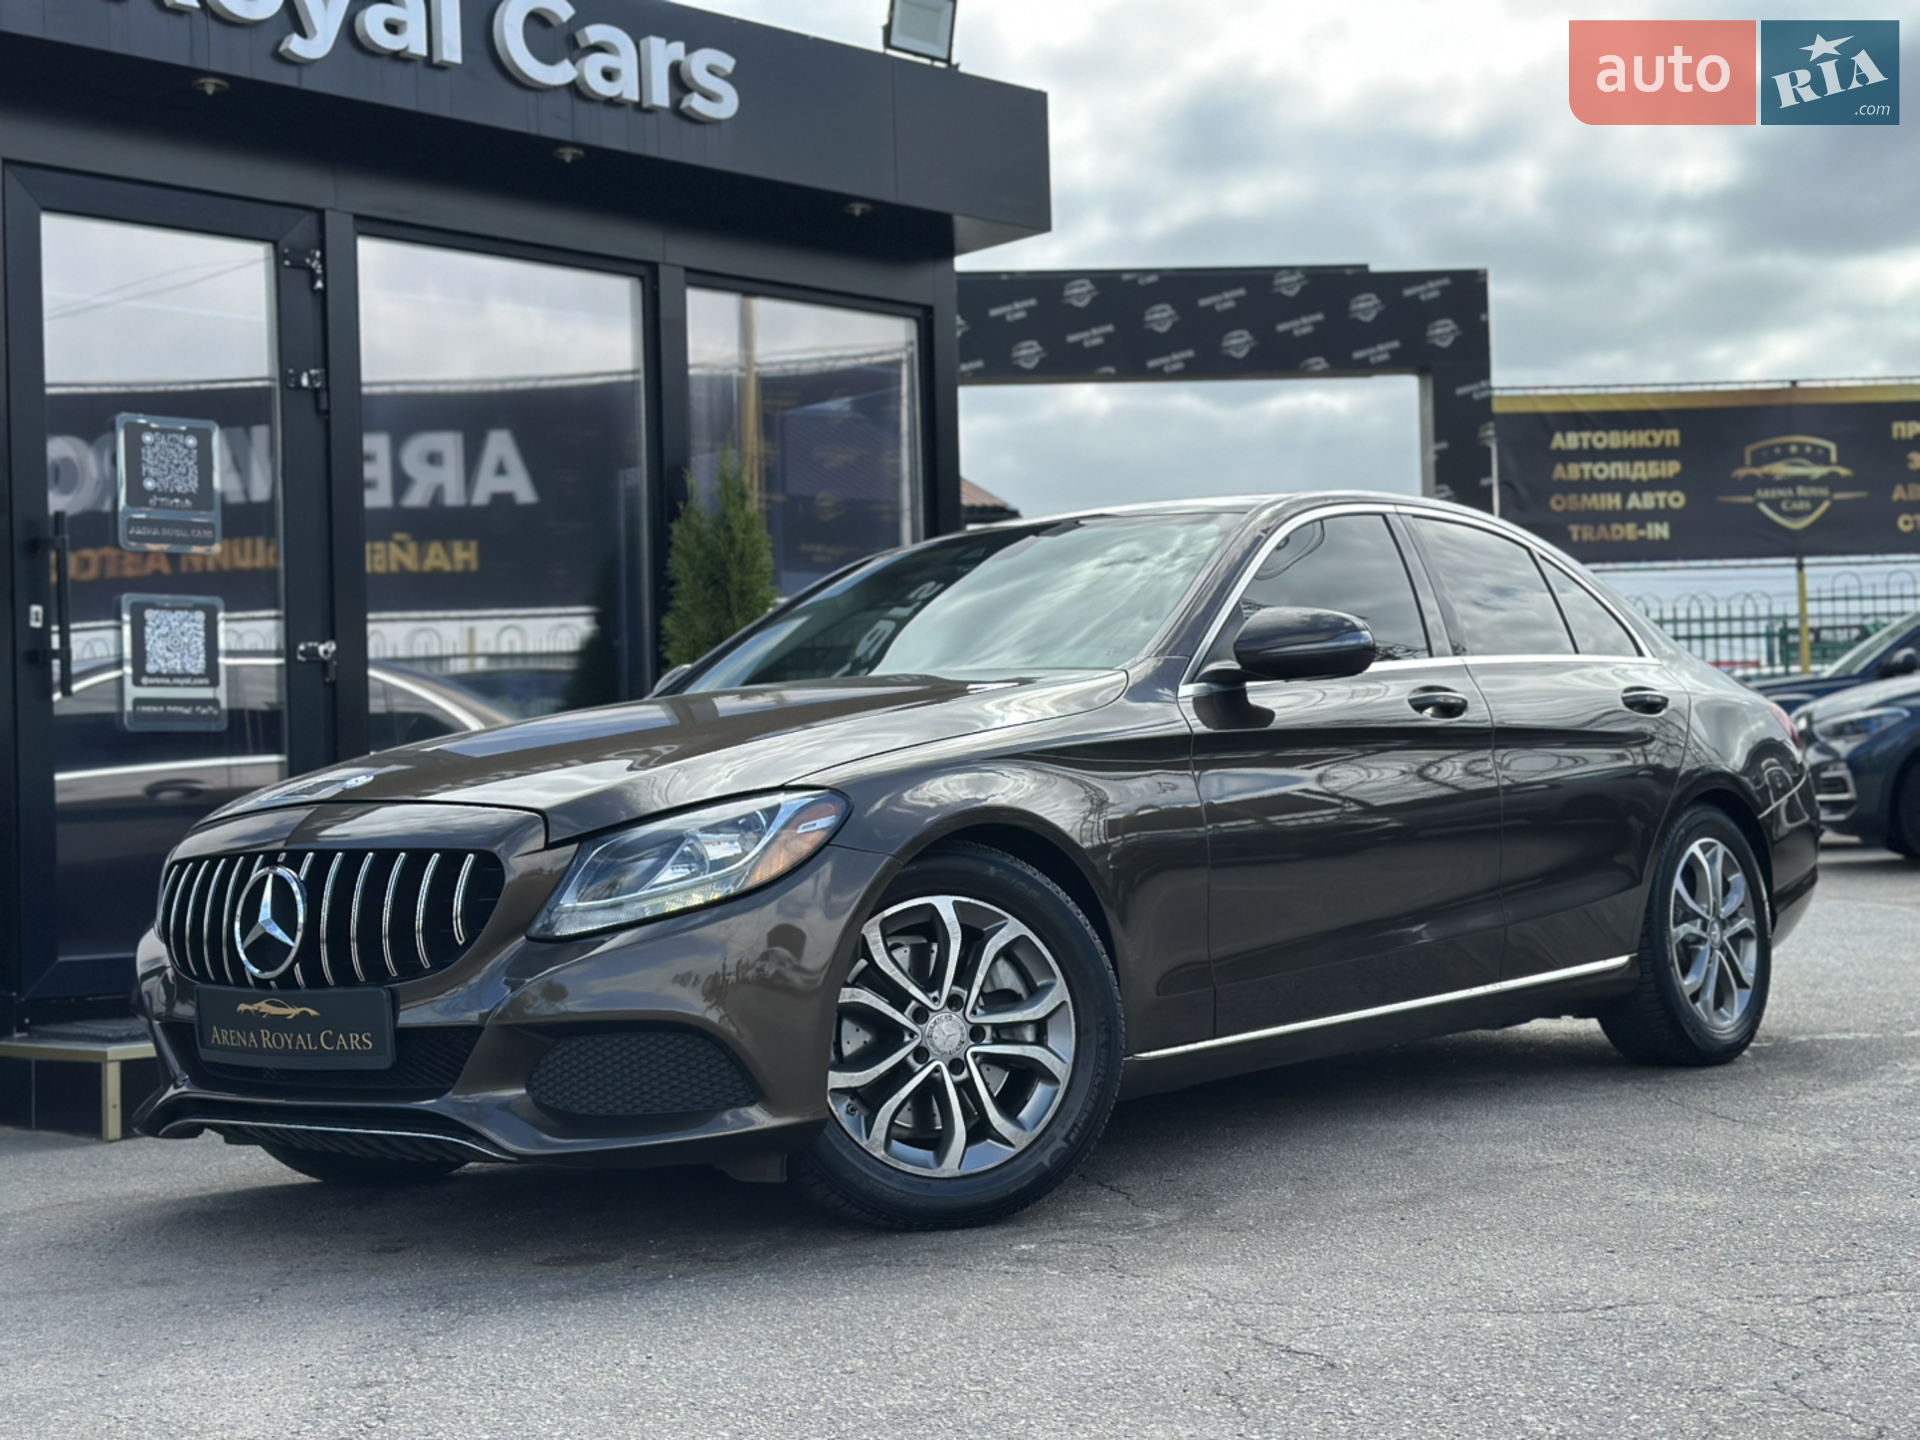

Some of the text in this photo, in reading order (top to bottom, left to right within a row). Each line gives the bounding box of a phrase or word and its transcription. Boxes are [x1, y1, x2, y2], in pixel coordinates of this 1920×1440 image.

[162, 0, 739, 123] yal Cars
[1550, 429, 1680, 450] АВТОВИКУП
[1552, 460, 1682, 482] АВТОПІДБІР
[1550, 490, 1686, 512] ОБМІН АВТО
[1567, 521, 1670, 542] TRADE-IN
[211, 1025, 373, 1051] ARENA ROYAL CARS
